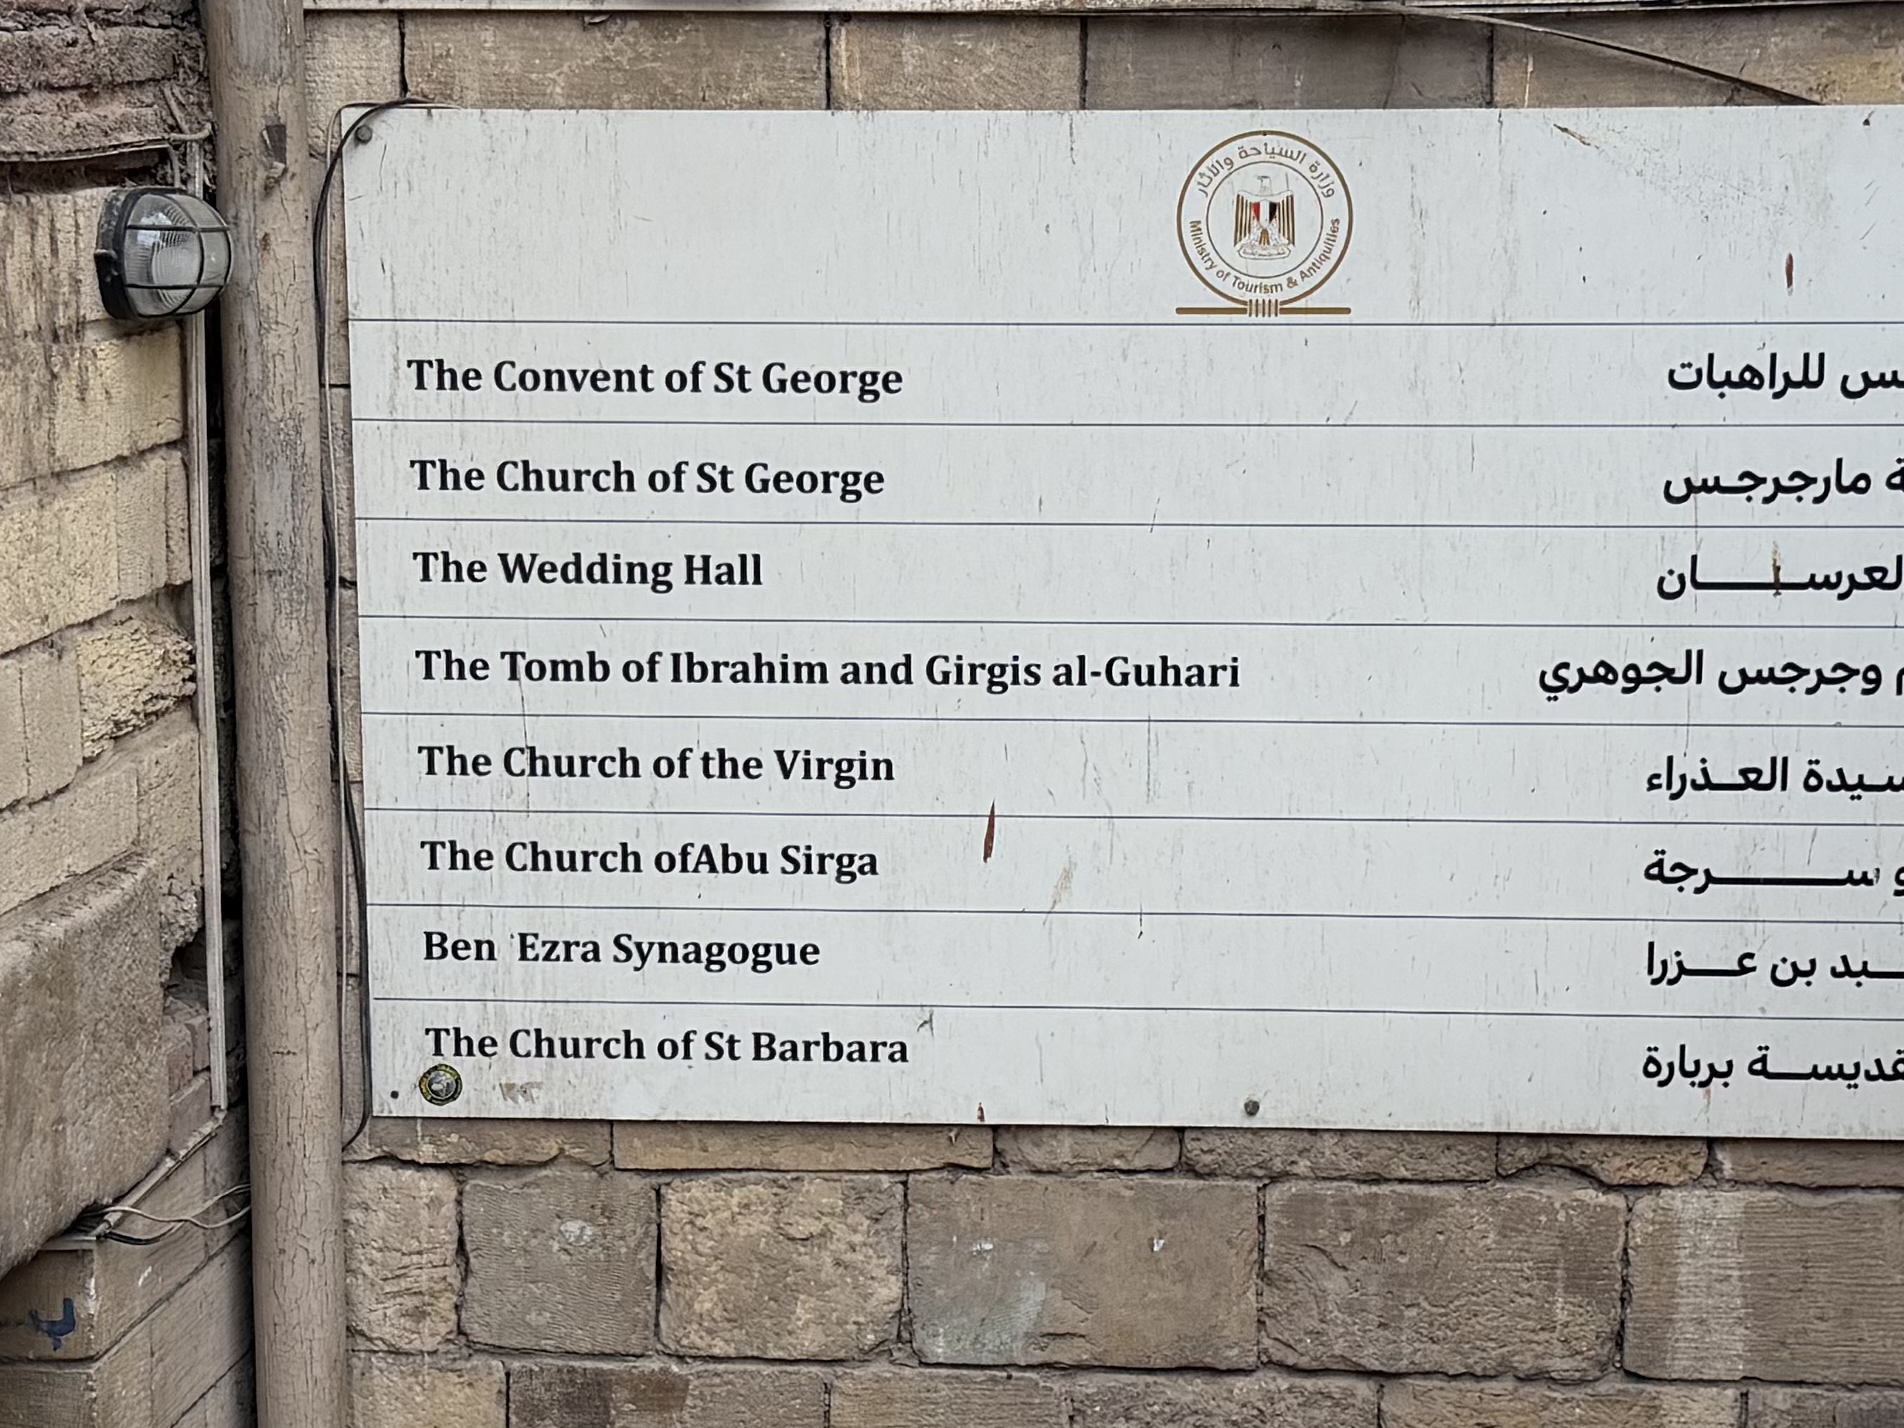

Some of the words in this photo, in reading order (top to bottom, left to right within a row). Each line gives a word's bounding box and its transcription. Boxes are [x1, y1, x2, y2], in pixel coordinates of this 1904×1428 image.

[1237, 142, 1307, 165] السياحة
[1308, 160, 1336, 199] وزارة
[1189, 219, 1218, 271] Ministry
[1216, 269, 1231, 283] of
[1231, 275, 1284, 295] Tourism
[1286, 276, 1299, 290] &
[1299, 217, 1342, 283] Antiquities
[407, 359, 482, 391] The
[494, 361, 654, 392] Convent
[665, 361, 706, 392] of
[714, 363, 751, 393] St
[763, 363, 902, 403] George
[1668, 352, 1824, 399] للراهبات
[410, 459, 484, 490] The
[497, 460, 635, 492] Church
[649, 461, 688, 492] of
[697, 463, 734, 493] St
[745, 463, 884, 503] George
[1663, 458, 1871, 504] مارجرجس
[413, 551, 487, 582] The
[498, 553, 672, 593] Wedding
[685, 554, 762, 585] Hall
[415, 650, 489, 680] The
[501, 651, 610, 682] Tomb
[623, 652, 662, 682] of
[671, 652, 828, 683] Ibrahim
[841, 654, 913, 684] and
[926, 655, 1041, 694] Girgis
[1053, 655, 1239, 687] al-Guhari
[1539, 649, 1703, 702] الجوهري
[1718, 662, 1883, 696] وجرجس
[418, 745, 491, 776] The
[504, 745, 641, 777] Church
[653, 748, 693, 778] of
[701, 748, 762, 779] the
[774, 750, 894, 789] Virgin
[1646, 755, 1788, 801] العذراء
[421, 840, 493, 870] The
[506, 841, 642, 872] Church
[781, 845, 878, 884] Sirga
[1643, 849, 1880, 895] سرجة
[424, 932, 496, 960] Ben
[614, 934, 819, 973] Synagogue
[1647, 941, 1757, 985] عزرا
[1770, 956, 1817, 987] بن
[424, 1027, 497, 1058] The
[510, 1028, 645, 1059] Church
[658, 1030, 697, 1059] of
[705, 1032, 740, 1060] St
[752, 1032, 908, 1062] Barbara
[1642, 1044, 1733, 1088] بربارة
